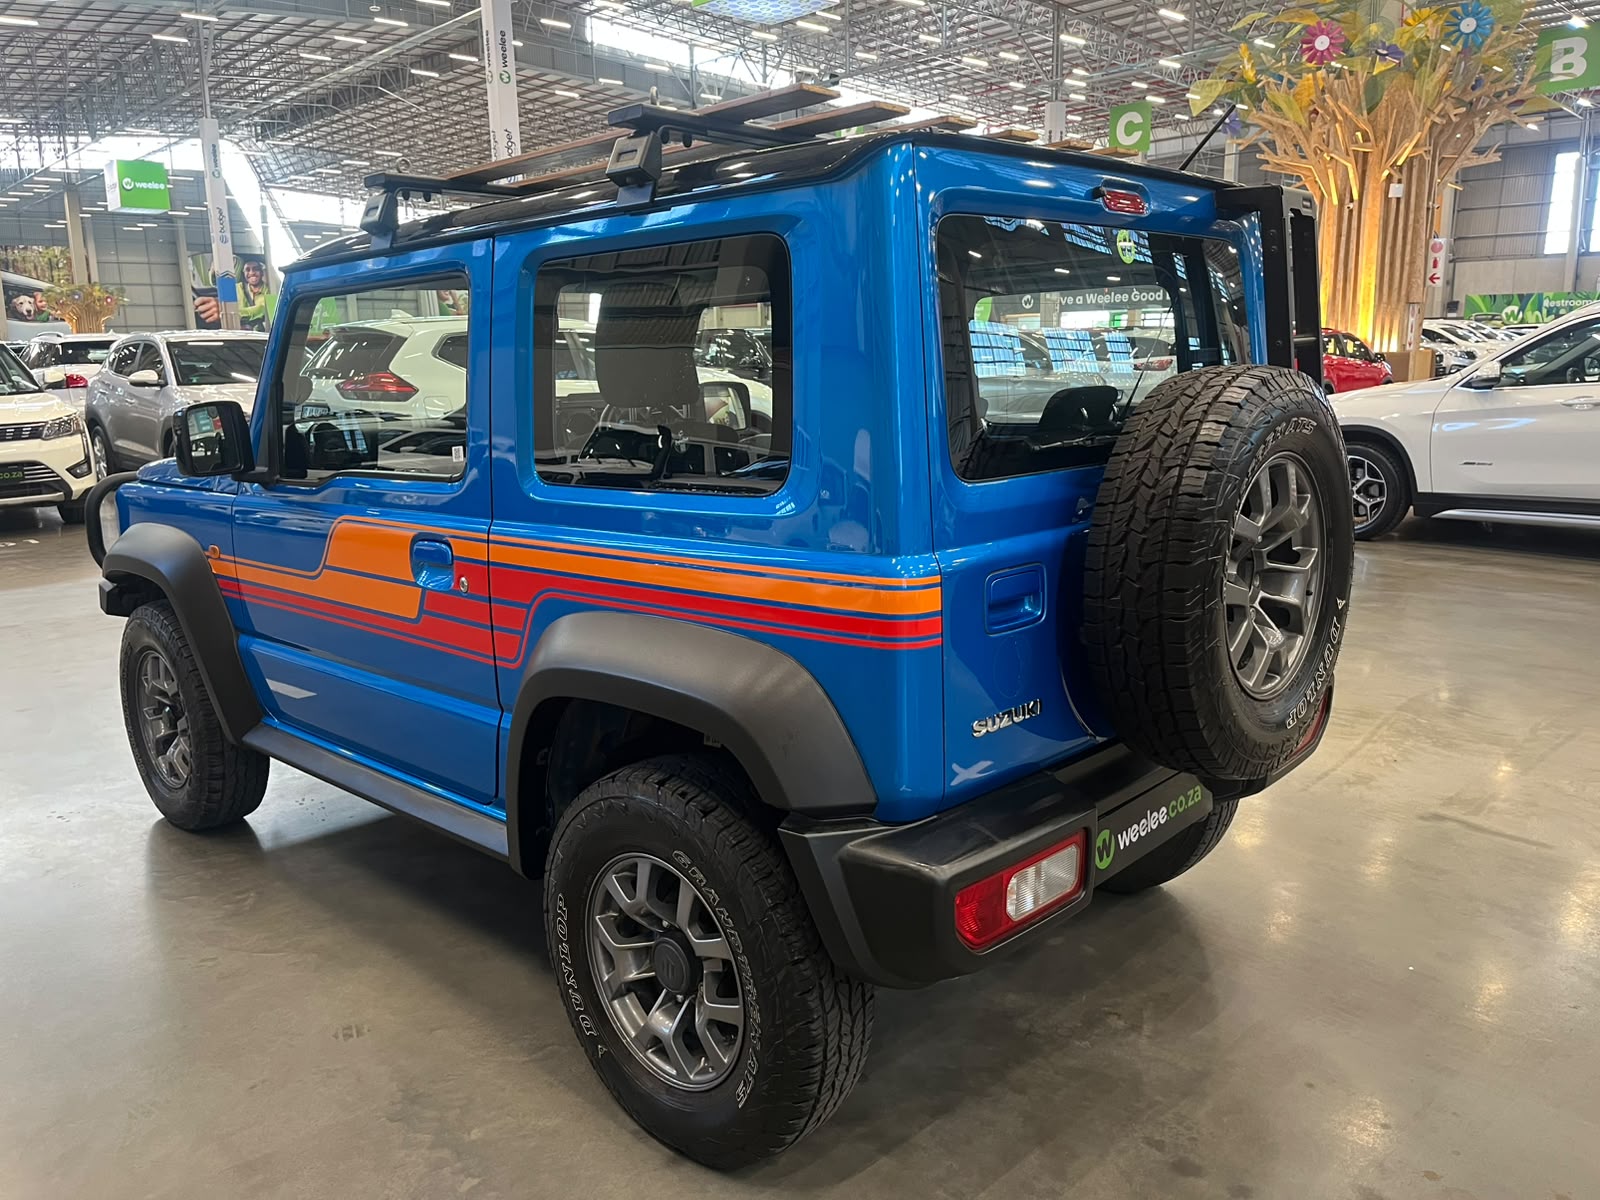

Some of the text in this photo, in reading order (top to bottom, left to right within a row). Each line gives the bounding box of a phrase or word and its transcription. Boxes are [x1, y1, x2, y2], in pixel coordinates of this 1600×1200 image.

[499, 30, 508, 68] weelee
[1549, 37, 1588, 82] B
[1116, 111, 1143, 146] C
[135, 181, 165, 190] weelee
[1075, 293, 1083, 305] a
[1086, 291, 1129, 304] Weelee
[1132, 289, 1163, 301] Good
[1286, 616, 1341, 730] DUNLOP
[972, 698, 1041, 738] SUZUKI
[1118, 785, 1202, 850] weelee.co.za
[556, 893, 598, 1036] DUNLOP
